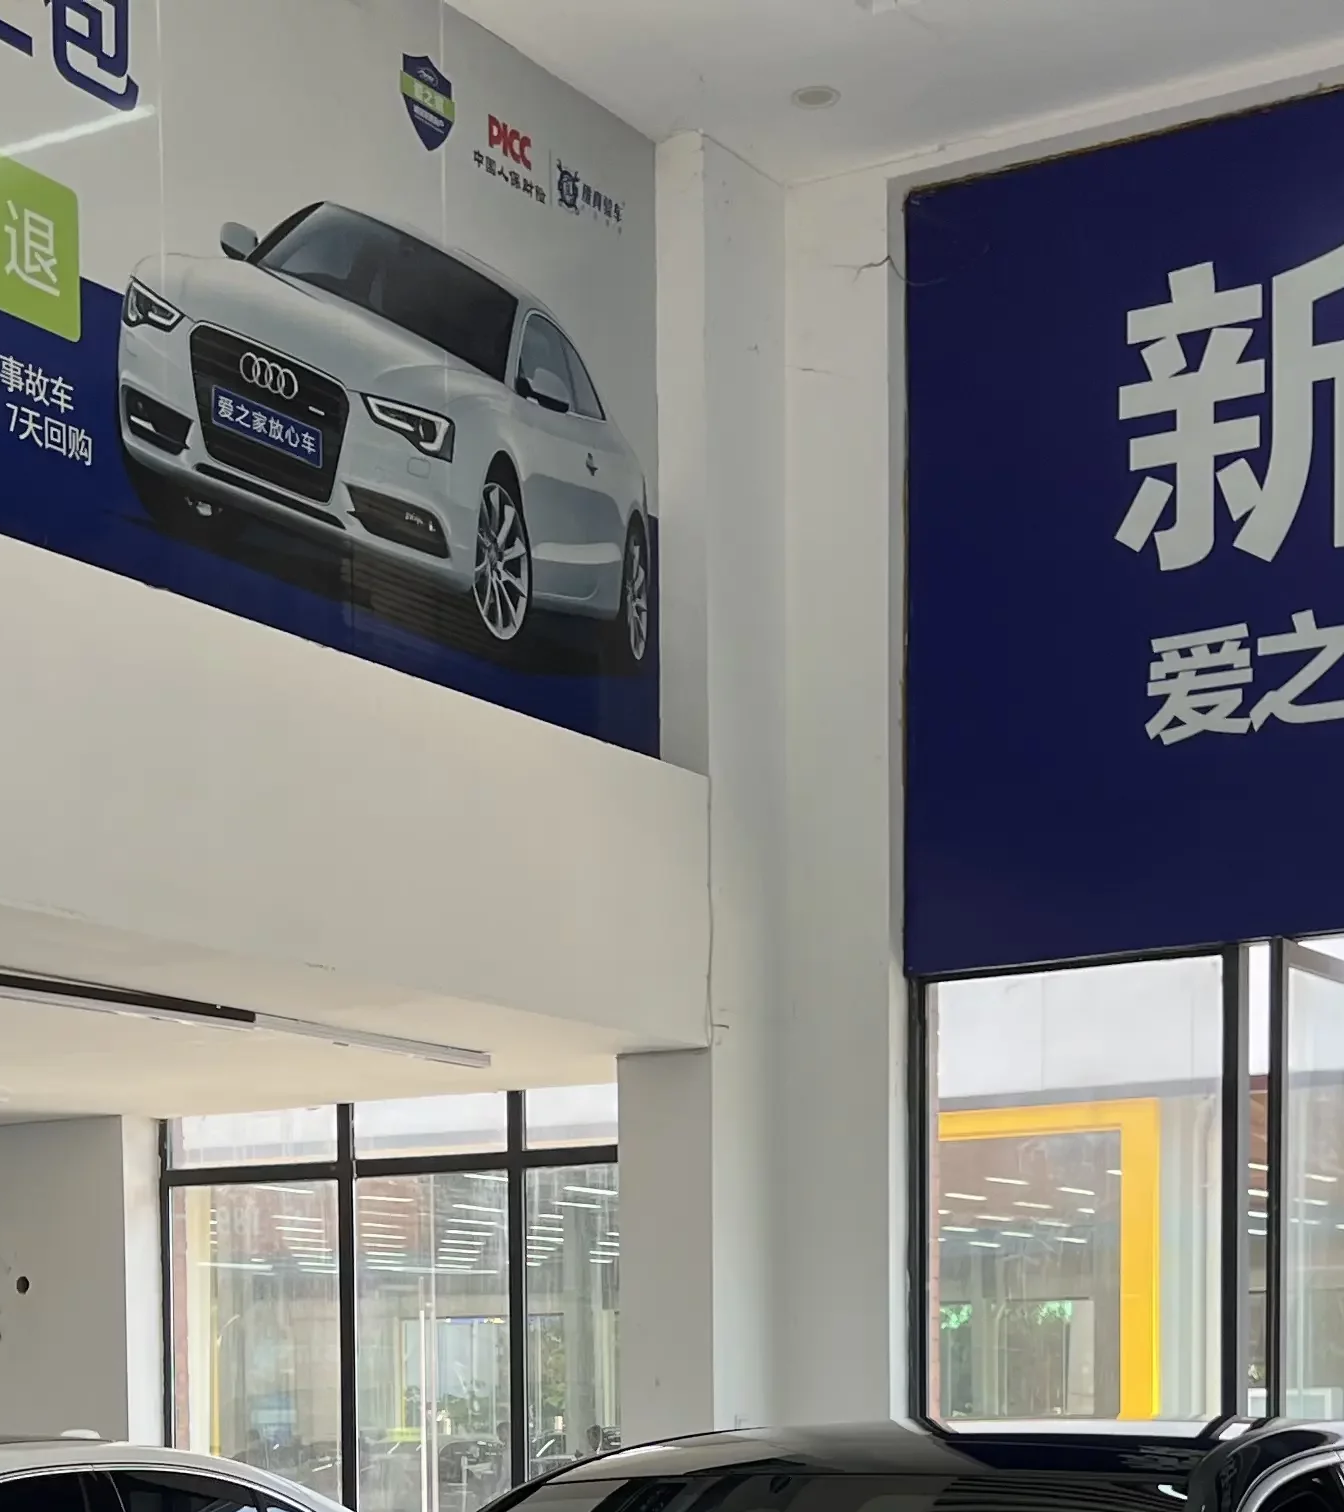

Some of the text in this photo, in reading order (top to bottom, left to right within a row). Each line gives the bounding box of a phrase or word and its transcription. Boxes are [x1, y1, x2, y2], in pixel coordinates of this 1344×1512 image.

[488, 114, 532, 170] PICC
[218, 395, 317, 454] 爱之家放心车
